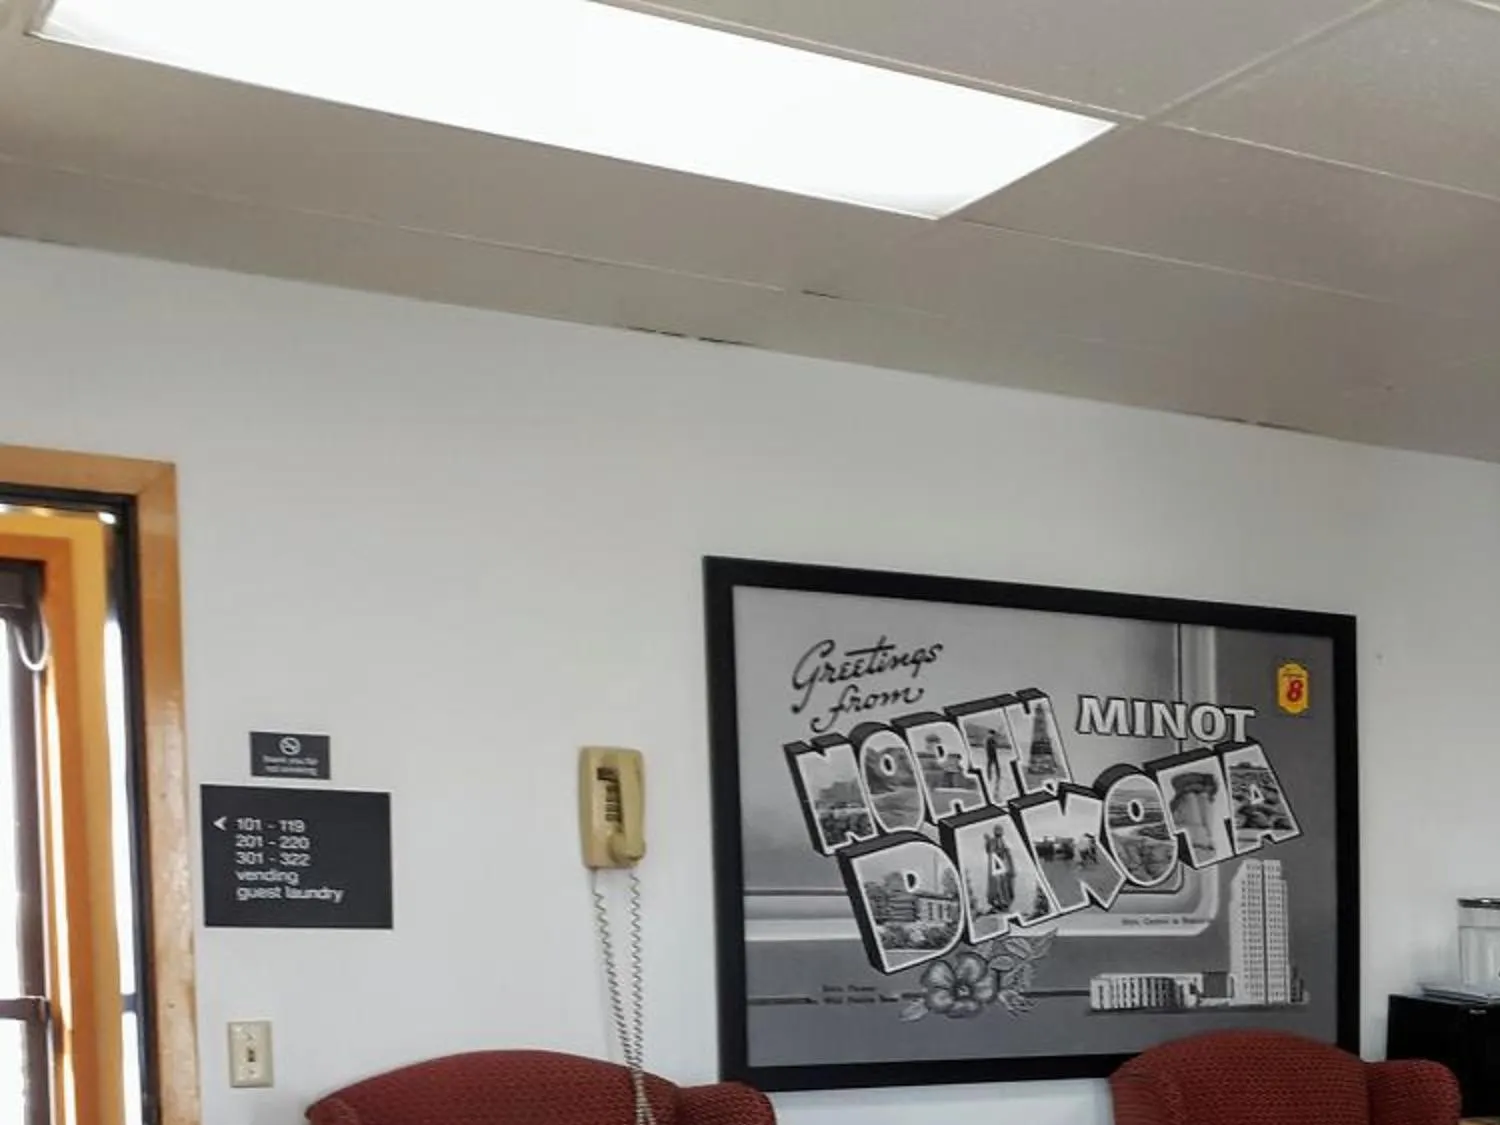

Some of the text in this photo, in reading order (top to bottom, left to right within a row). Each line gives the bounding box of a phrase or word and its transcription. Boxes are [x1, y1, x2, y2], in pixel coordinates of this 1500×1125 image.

[791, 634, 943, 714] Greetings
[810, 684, 924, 733] from
[1076, 694, 1256, 743] MINOT
[784, 688, 1072, 856] NORTH
[235, 834, 263, 848] 201
[279, 835, 310, 849] 220
[236, 818, 262, 831] 101
[279, 819, 306, 833] 119
[235, 851, 263, 865] 301
[279, 852, 311, 867] 322
[836, 740, 1303, 974] DAKOTA
[235, 869, 299, 886] vending
[236, 886, 344, 903] guest laundry
